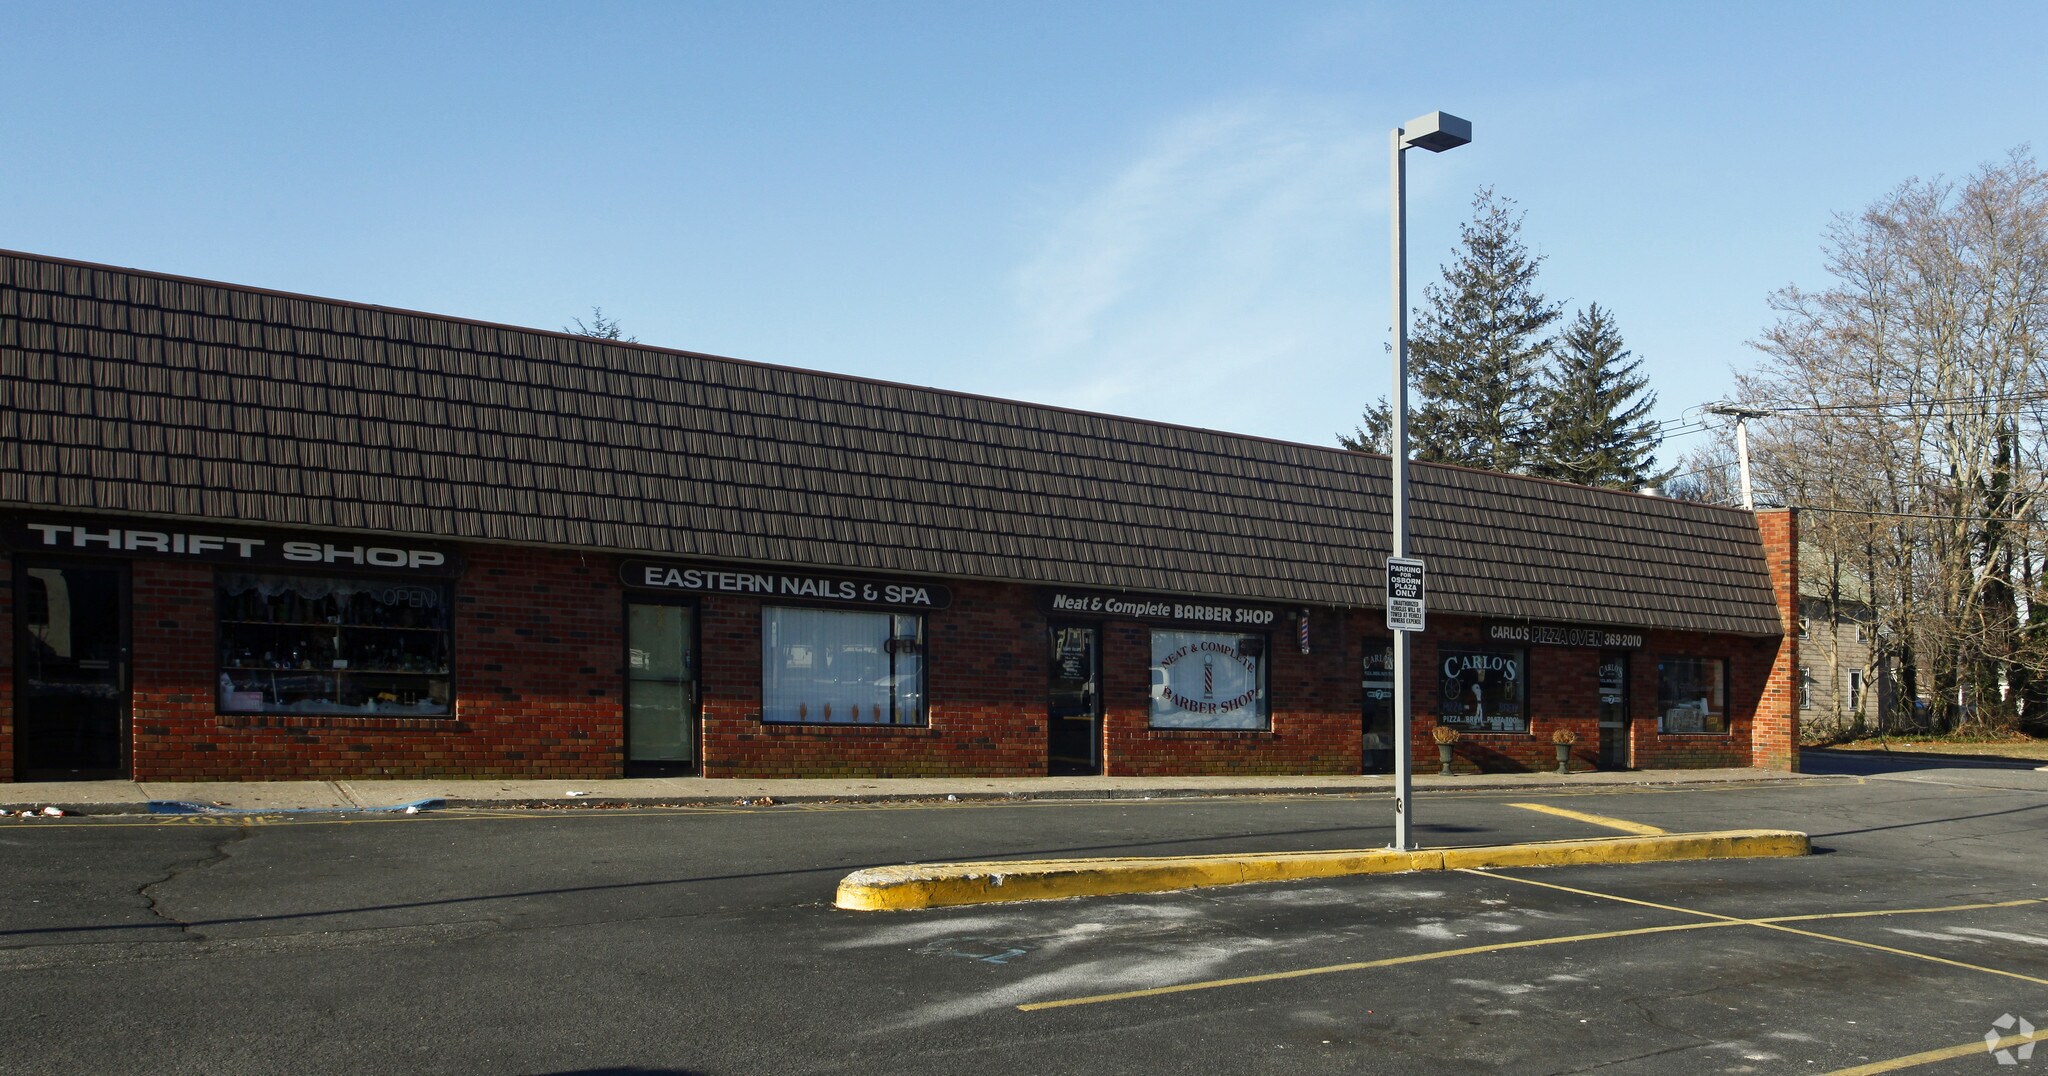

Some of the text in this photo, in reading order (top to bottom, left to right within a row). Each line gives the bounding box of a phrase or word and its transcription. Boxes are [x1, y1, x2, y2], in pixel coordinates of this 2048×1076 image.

[28, 524, 445, 569] THRIFT SHOP
[1390, 565, 1421, 574] PARKING
[1391, 577, 1421, 585] OSBORN
[383, 588, 433, 609] OPEN
[645, 567, 930, 605] EASTERN NAILS & SPA
[1053, 594, 1274, 624] Neat & Complete BARBER SHOP
[1491, 625, 1529, 640] CARLO'S
[1532, 626, 1568, 644] PIZZA
[1570, 630, 1603, 646] OVEN
[1161, 641, 1255, 674] NEAT & COMPLETE
[1444, 655, 1517, 680] CARLO'S
[1599, 663, 1623, 678] CARLO'S
[1162, 685, 1257, 714] BARBER SHOP
